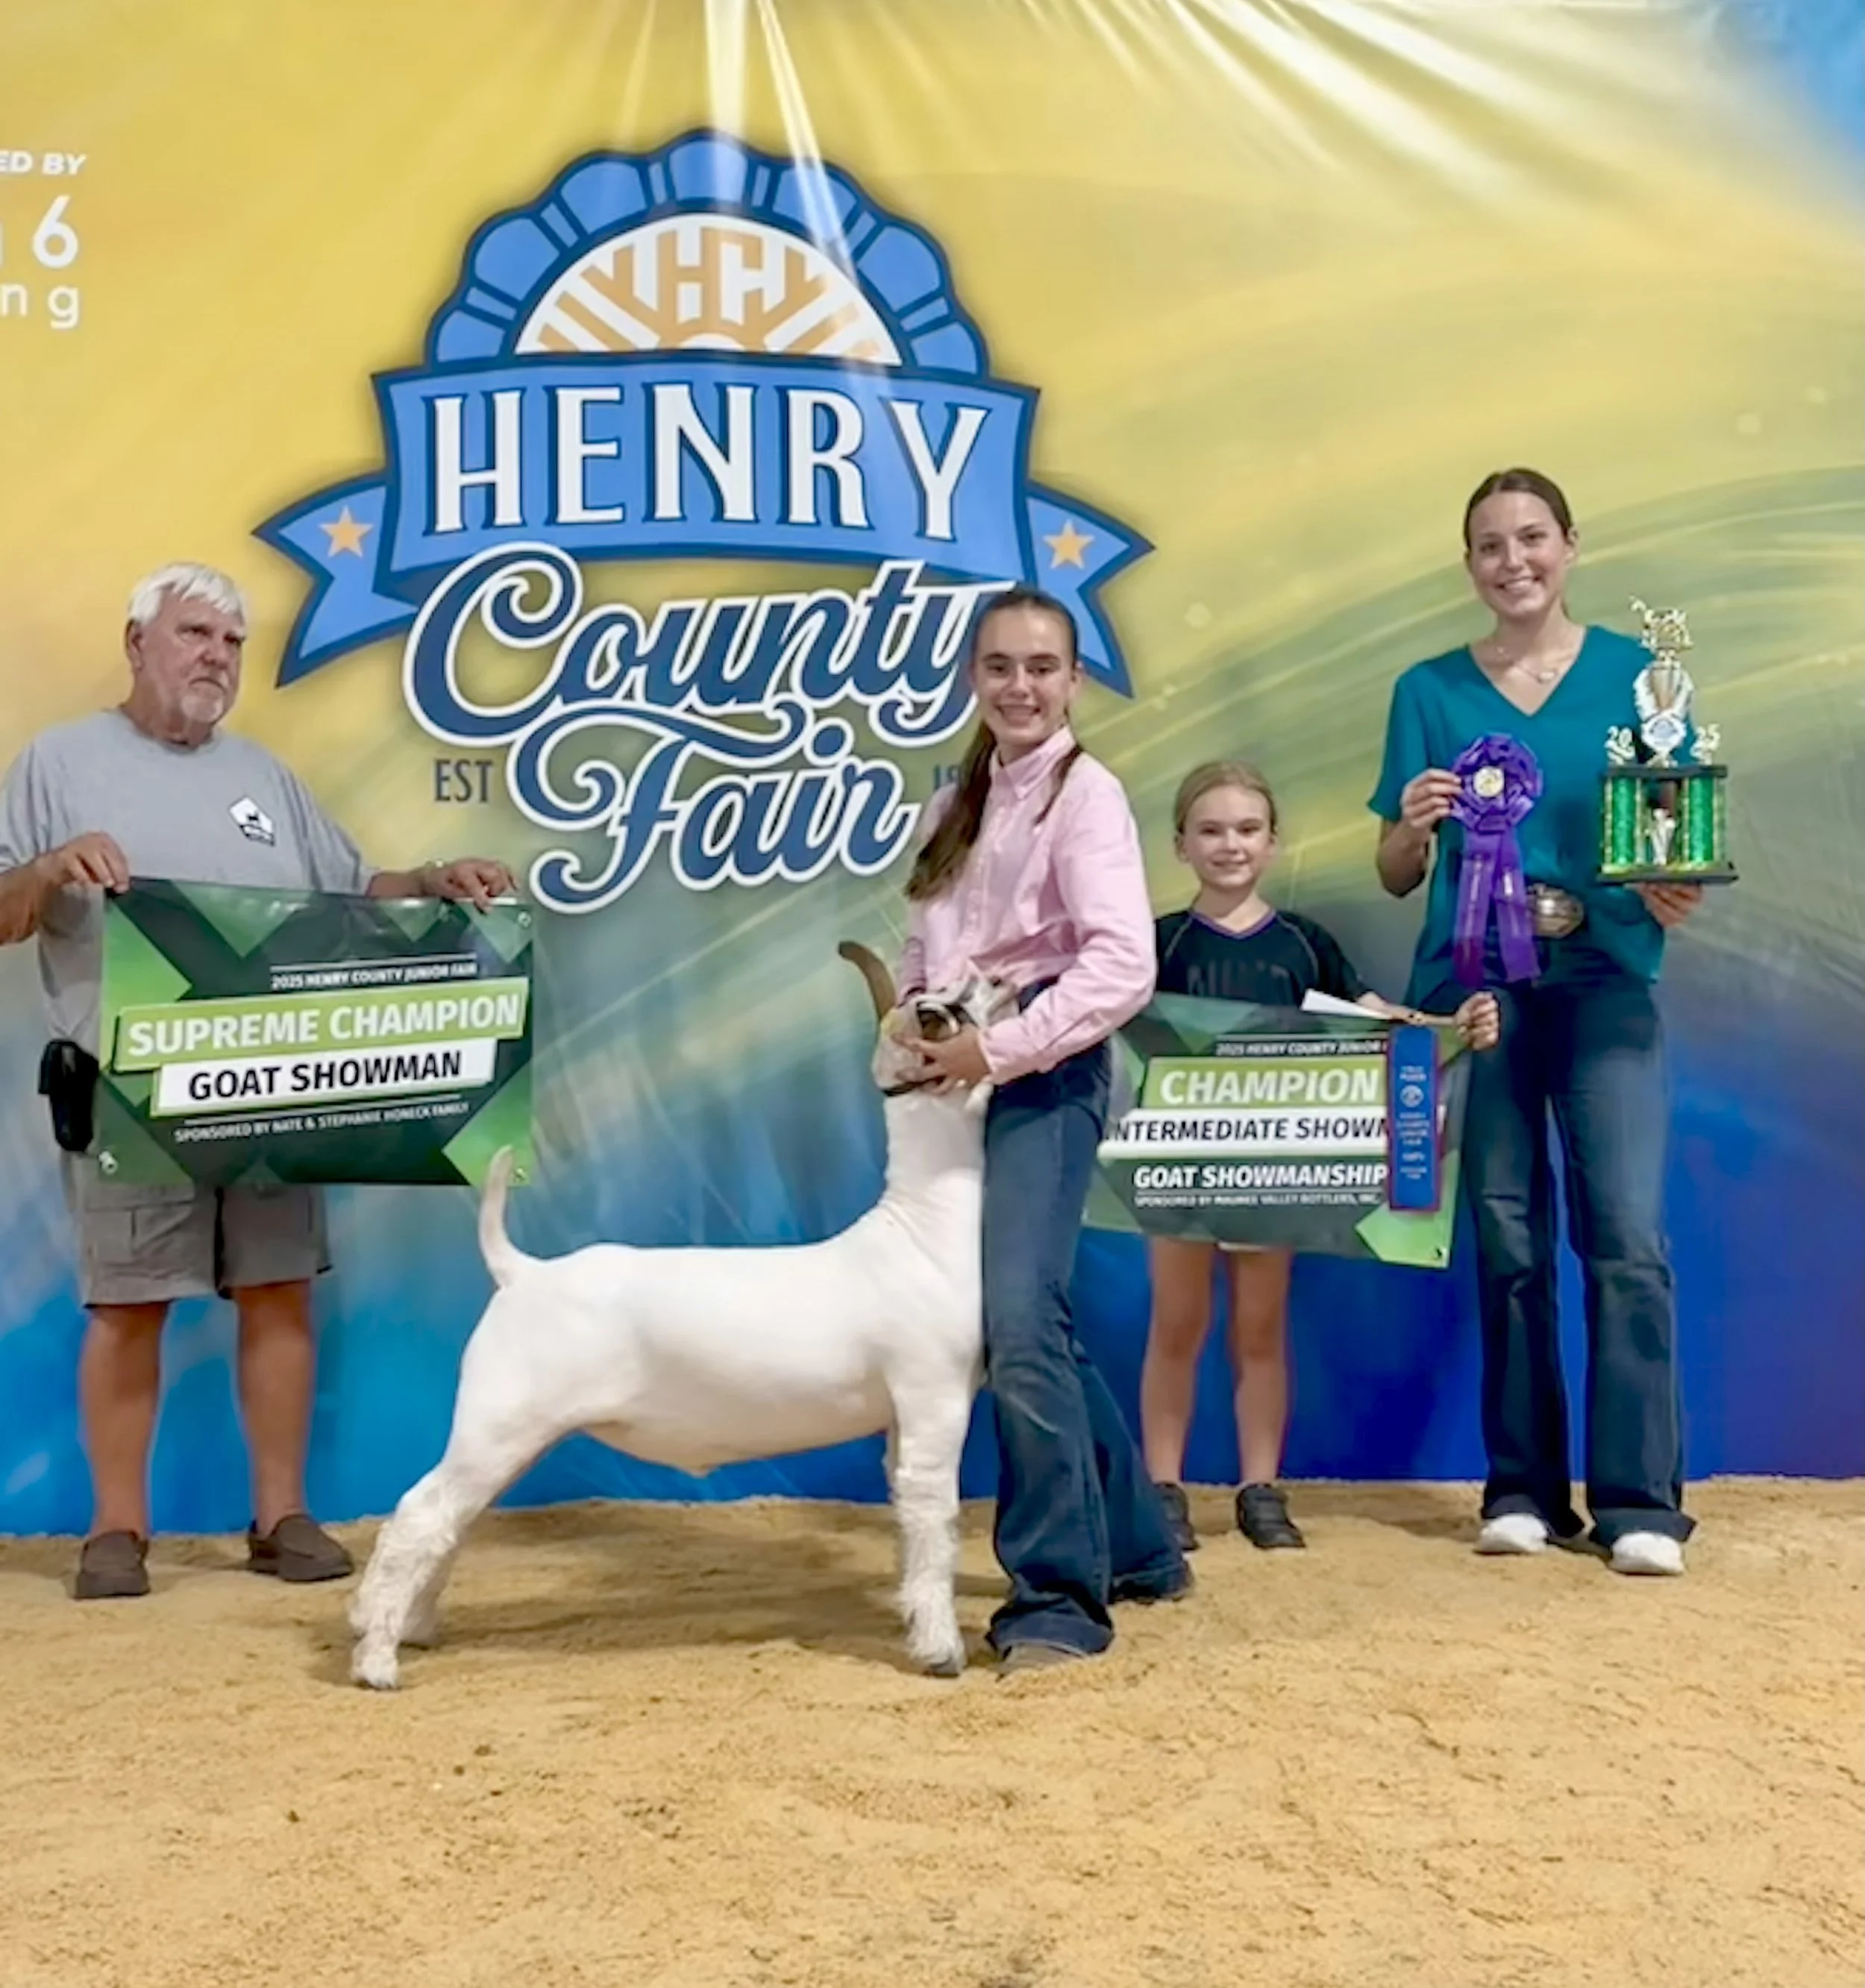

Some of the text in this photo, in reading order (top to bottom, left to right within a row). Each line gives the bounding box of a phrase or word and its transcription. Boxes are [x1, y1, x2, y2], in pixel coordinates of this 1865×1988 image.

[43, 152, 87, 175] BY
[33, 195, 78, 268] 6
[430, 380, 989, 542] HENRY
[404, 542, 1016, 747] County
[434, 759, 493, 802] EST
[505, 701, 921, 913] Fair
[272, 973, 304, 990] 2025
[304, 970, 348, 986] HENRY
[351, 968, 404, 984] COUNTY
[403, 965, 448, 981] JUNIOR
[128, 994, 518, 1056] SUPREME CHAMPION
[189, 1050, 463, 1100] GOAT SHOWMAN
[1160, 1067, 1379, 1106] CHAMPION
[174, 1126, 251, 1143] SPONSORED
[254, 1122, 272, 1135] BY
[272, 1118, 303, 1134] NATE
[304, 1116, 316, 1131] &
[318, 1113, 380, 1129] STEPHANIE
[1105, 1118, 1288, 1141] NTERMEDIATE
[1133, 1166, 1198, 1188] GOAT
[1200, 1163, 1388, 1188] SHOWMANSHIP
